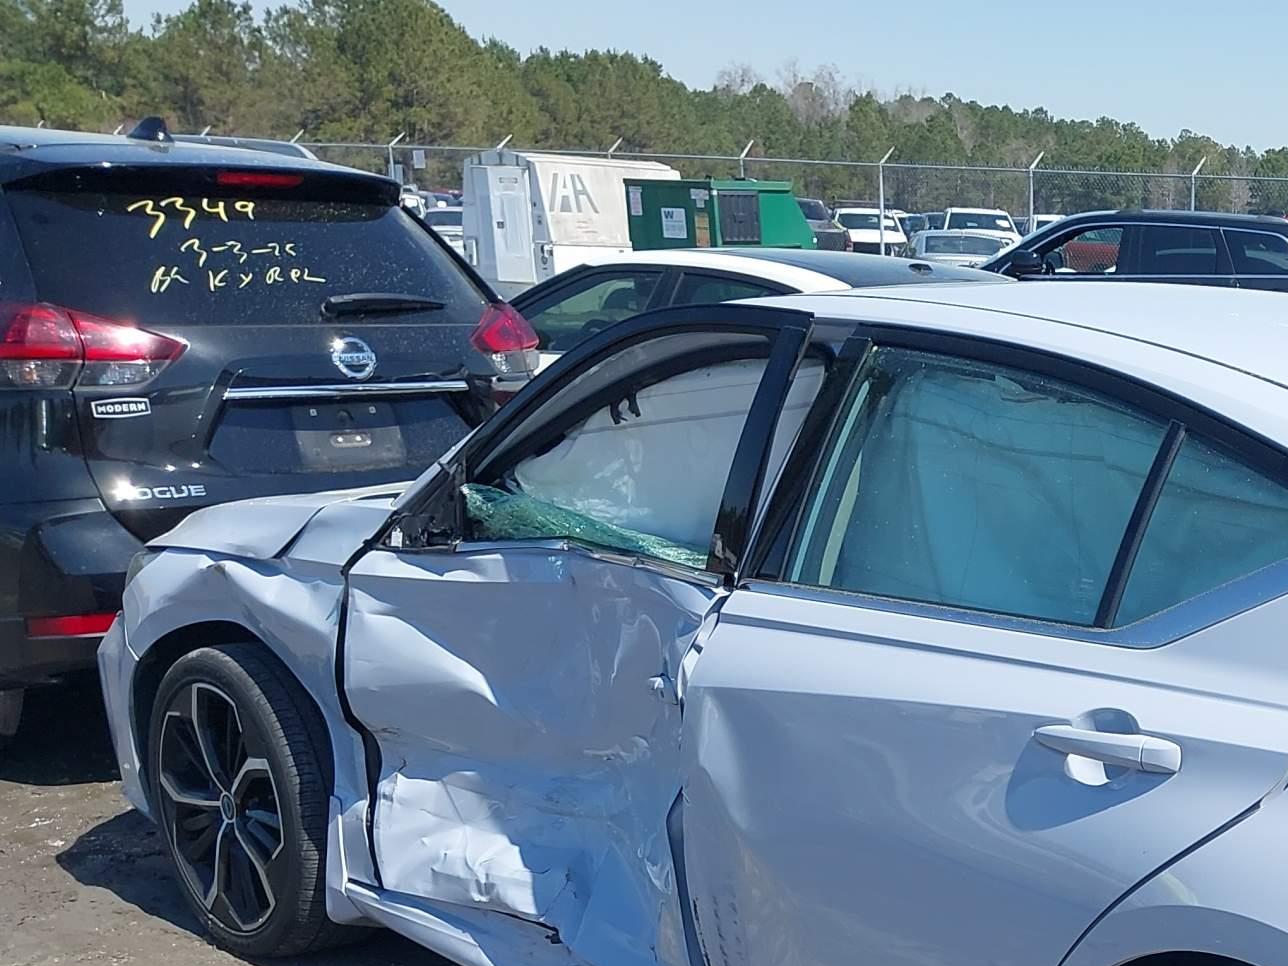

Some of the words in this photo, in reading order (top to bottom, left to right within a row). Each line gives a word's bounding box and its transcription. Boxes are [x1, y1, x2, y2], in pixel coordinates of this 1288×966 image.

[127, 197, 255, 239] 3349
[96, 402, 146, 413] MODERN
[118, 484, 207, 500] OGUE
